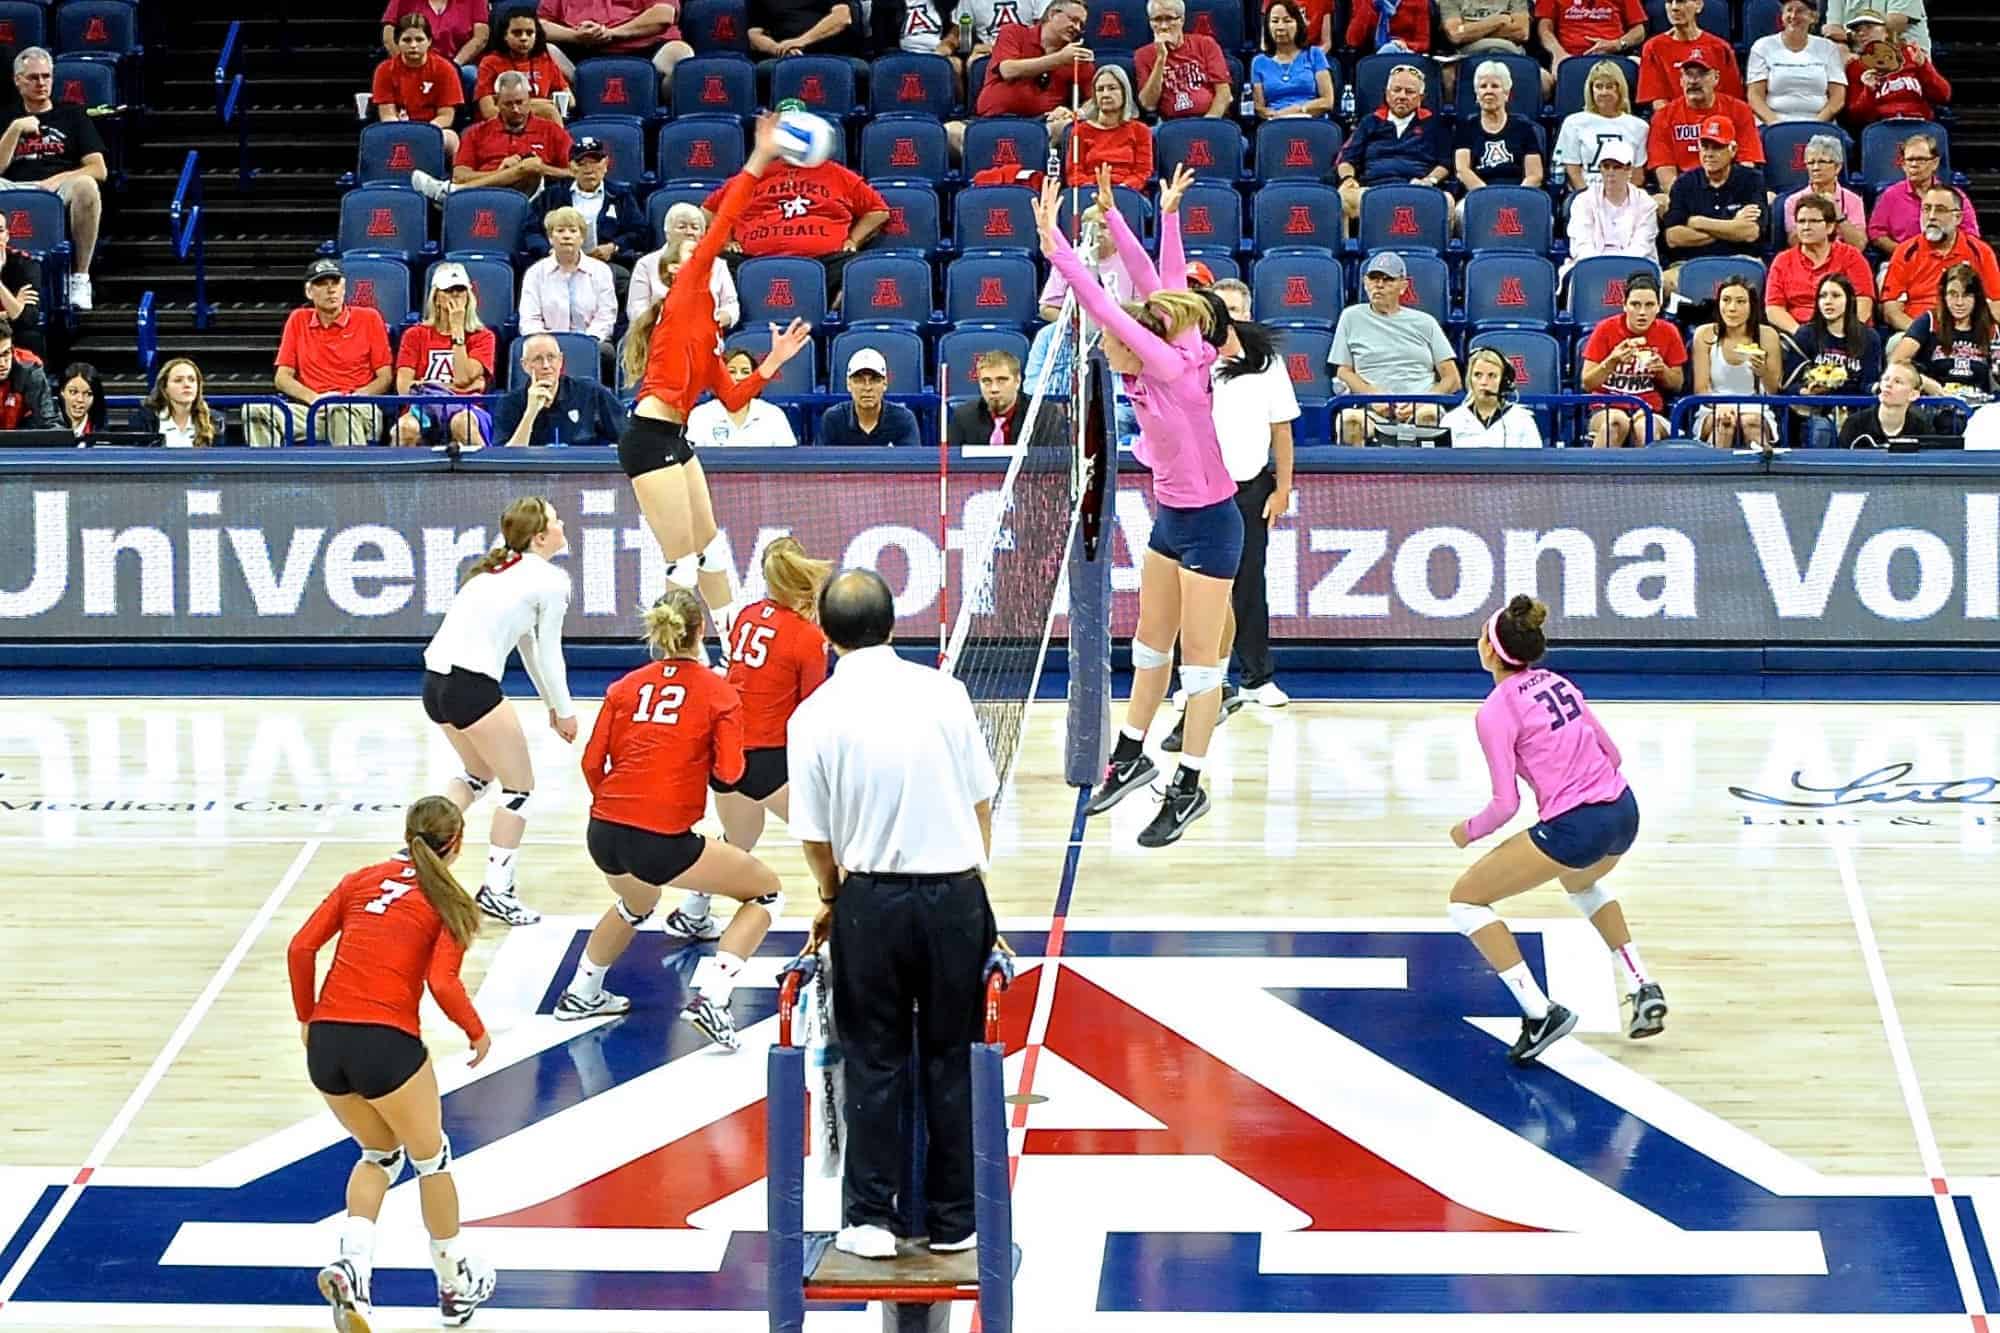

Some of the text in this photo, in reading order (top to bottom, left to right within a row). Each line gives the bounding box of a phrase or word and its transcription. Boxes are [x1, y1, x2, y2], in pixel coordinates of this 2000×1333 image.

[900, 5, 942, 38] A
[1480, 140, 1514, 168] A
[1735, 491, 2000, 622] Vol
[732, 621, 777, 669] 15
[632, 683, 686, 725] 12
[1532, 680, 1582, 731] 35
[364, 878, 412, 915] 7
